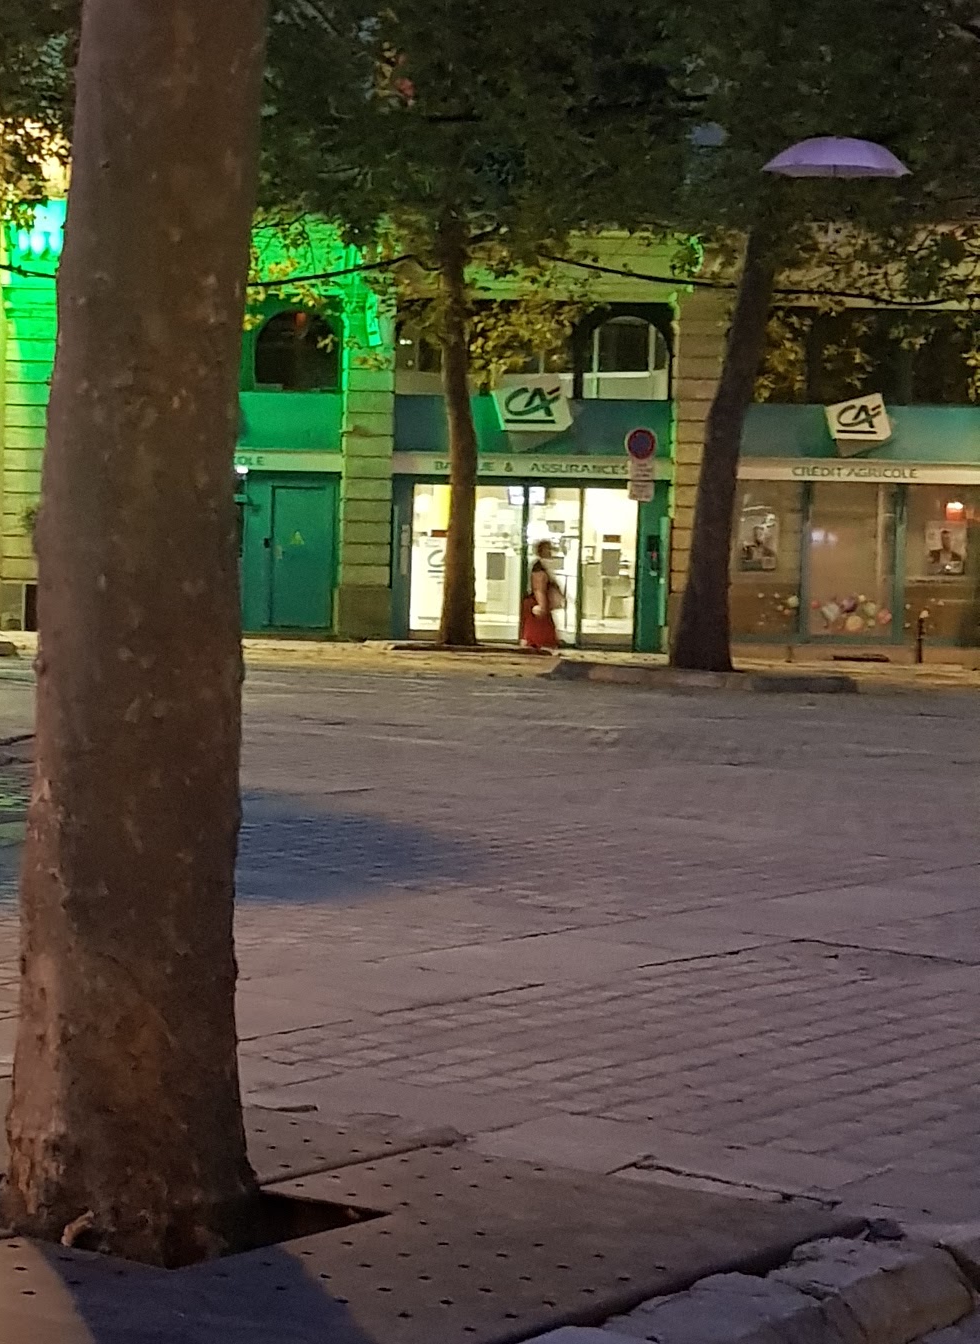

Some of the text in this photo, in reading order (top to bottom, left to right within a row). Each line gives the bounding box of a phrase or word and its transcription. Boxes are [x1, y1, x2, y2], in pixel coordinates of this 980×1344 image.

[503, 461, 514, 473] &
[529, 461, 629, 476] ASSURANCES
[845, 466, 919, 480] AGRICOLE
